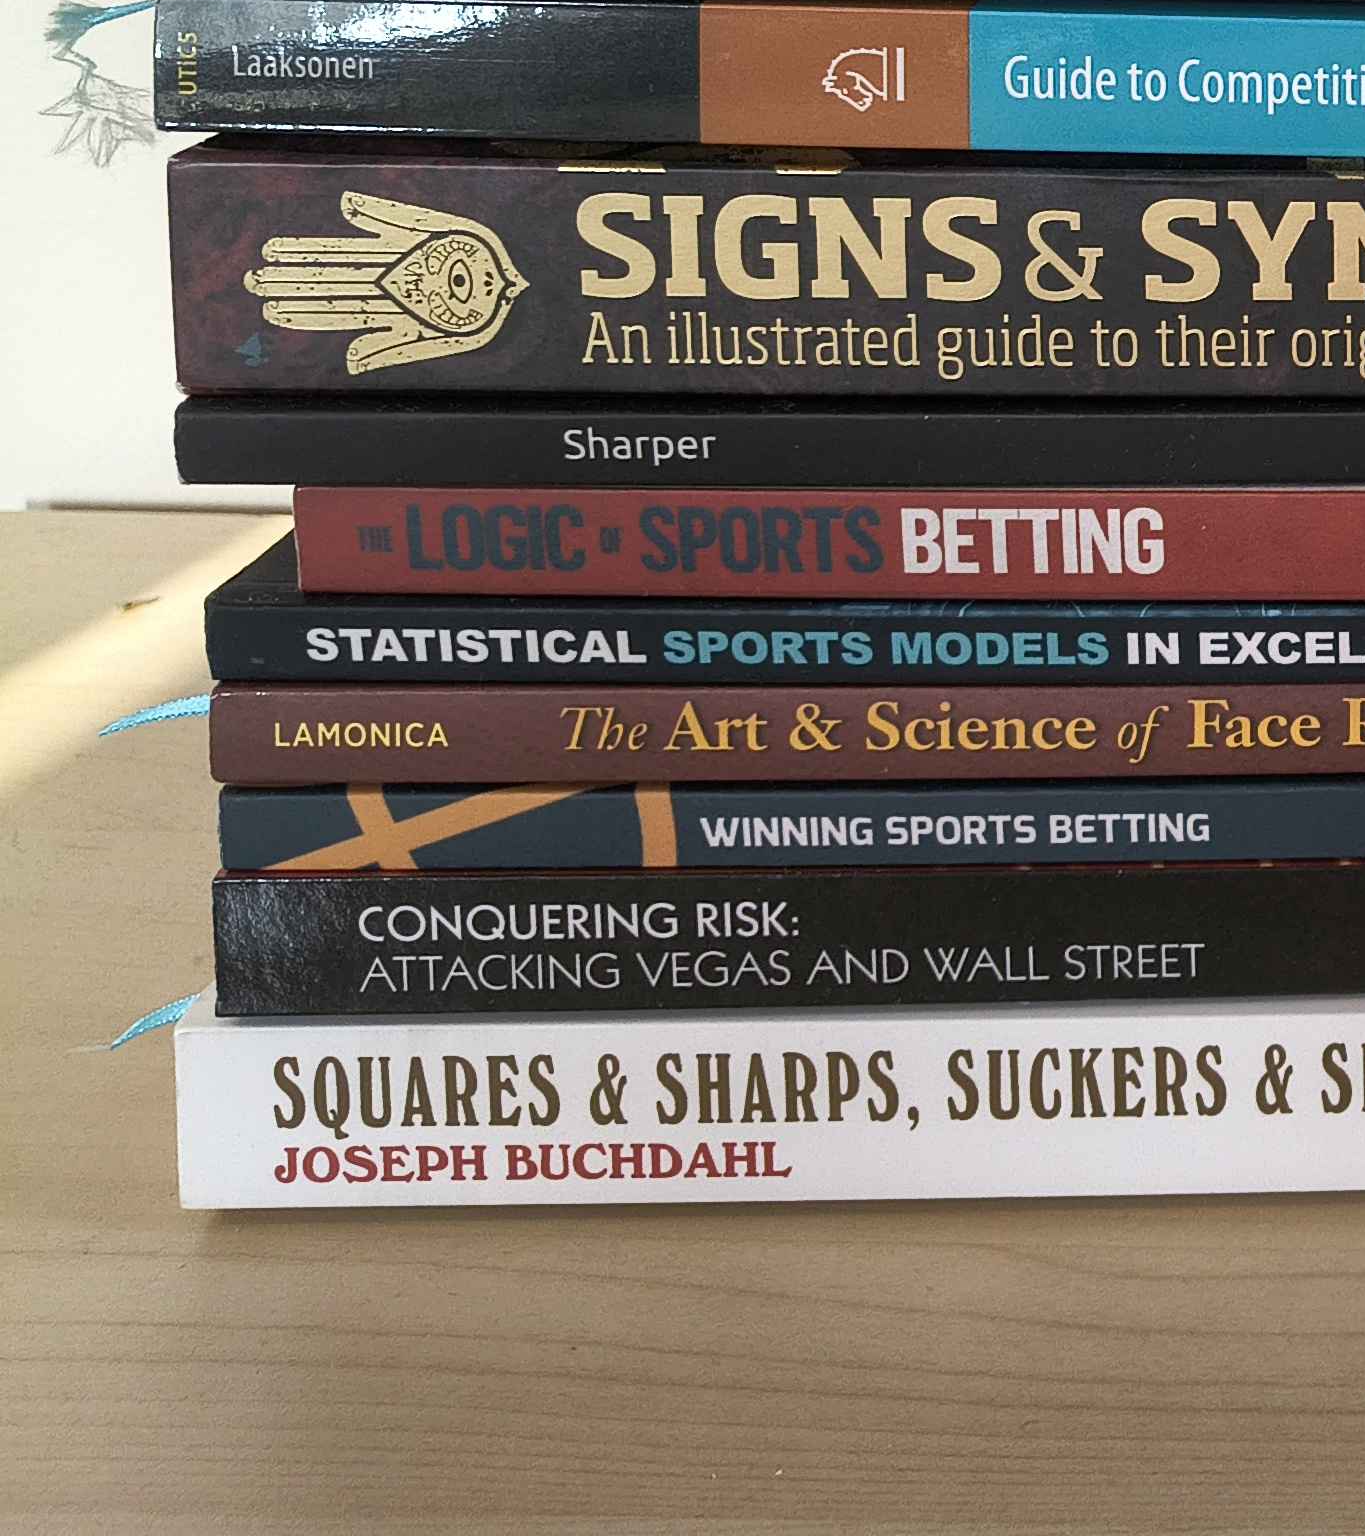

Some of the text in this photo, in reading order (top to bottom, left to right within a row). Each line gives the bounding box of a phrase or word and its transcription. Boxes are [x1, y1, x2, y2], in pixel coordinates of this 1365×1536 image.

[232, 45, 374, 79] Laaksonen
[1005, 56, 1116, 100] Guide
[1127, 63, 1168, 101] to
[577, 193, 1001, 301] SIGNS
[1025, 210, 1103, 301] &
[582, 312, 651, 363] An
[667, 312, 920, 366] illustrated
[938, 314, 1073, 379] guide
[1090, 320, 1137, 366] to
[1178, 315, 1275, 366] their
[564, 427, 716, 466] Sharper
[357, 526, 394, 554] THE
[406, 504, 586, 572] LOGIC
[640, 505, 884, 575] SPORTS
[901, 507, 1164, 574] BETTING
[307, 628, 1365, 665] STATISTICAL SPORTS MODELS IN EXCEL
[275, 723, 448, 747] LAMONICA
[560, 708, 647, 750] The
[664, 701, 767, 750] Art
[790, 704, 841, 750] &
[866, 702, 1096, 750] Science
[1118, 706, 1169, 763] of
[1187, 700, 1320, 747] Face
[700, 813, 1210, 847] WINNING SPORTS BETTING
[359, 902, 798, 942] CONQUERING RISK:
[360, 944, 1205, 992] ATTACKING VEGAS AND WALL STREET
[274, 1055, 560, 1140] SQUARES
[590, 1054, 628, 1125] &
[656, 1050, 919, 1131] SHARPS,
[948, 1045, 1226, 1120] SUCKERS
[1256, 1044, 1293, 1115] &
[275, 1142, 792, 1183] JOSEPH BUCHDAHL
